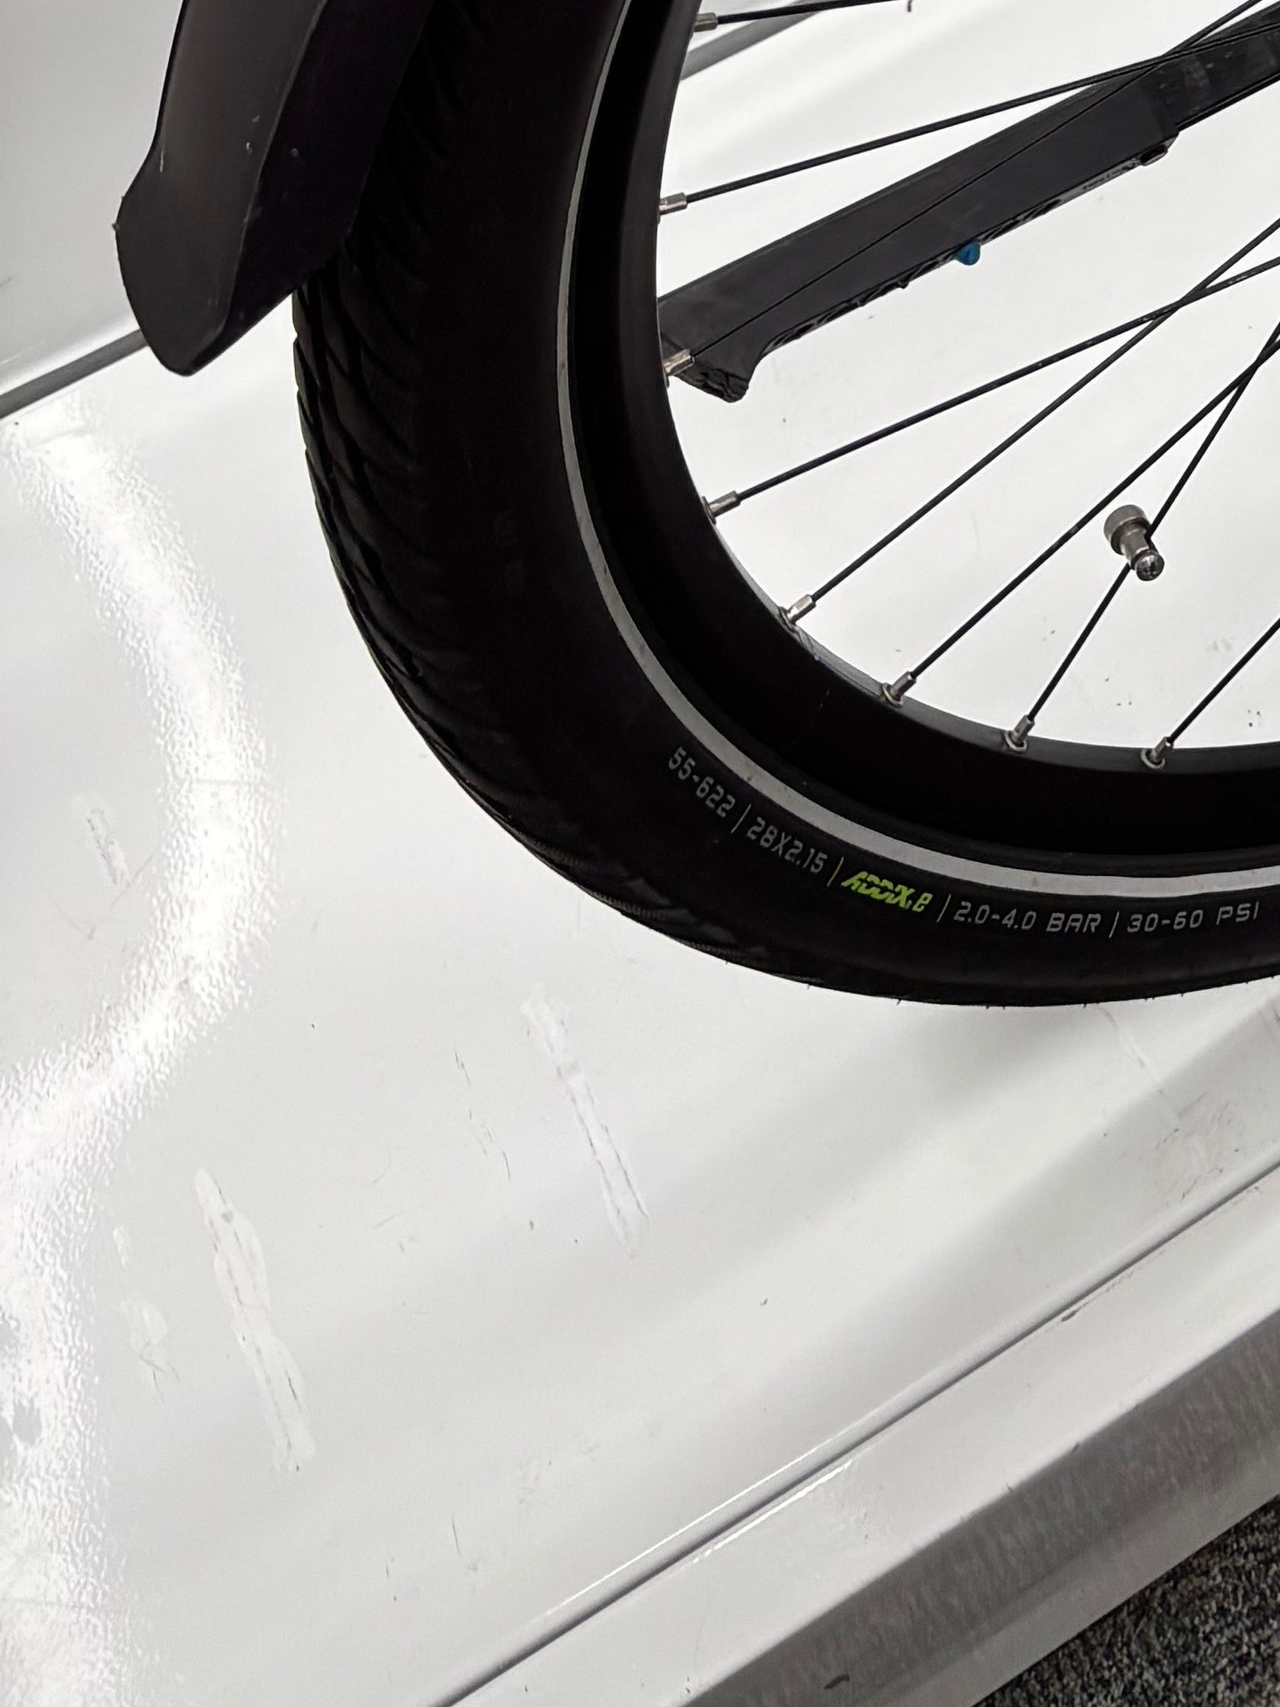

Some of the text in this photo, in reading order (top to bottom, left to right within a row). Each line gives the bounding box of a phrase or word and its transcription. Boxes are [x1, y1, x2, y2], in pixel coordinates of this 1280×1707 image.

[668, 746, 736, 819] 55-622
[746, 816, 829, 875] 28X2.15
[953, 900, 1038, 932] 2.0-4.0
[1045, 911, 1101, 935] BAR
[1126, 908, 1205, 934] 30-60
[1215, 900, 1261, 927] PSI
